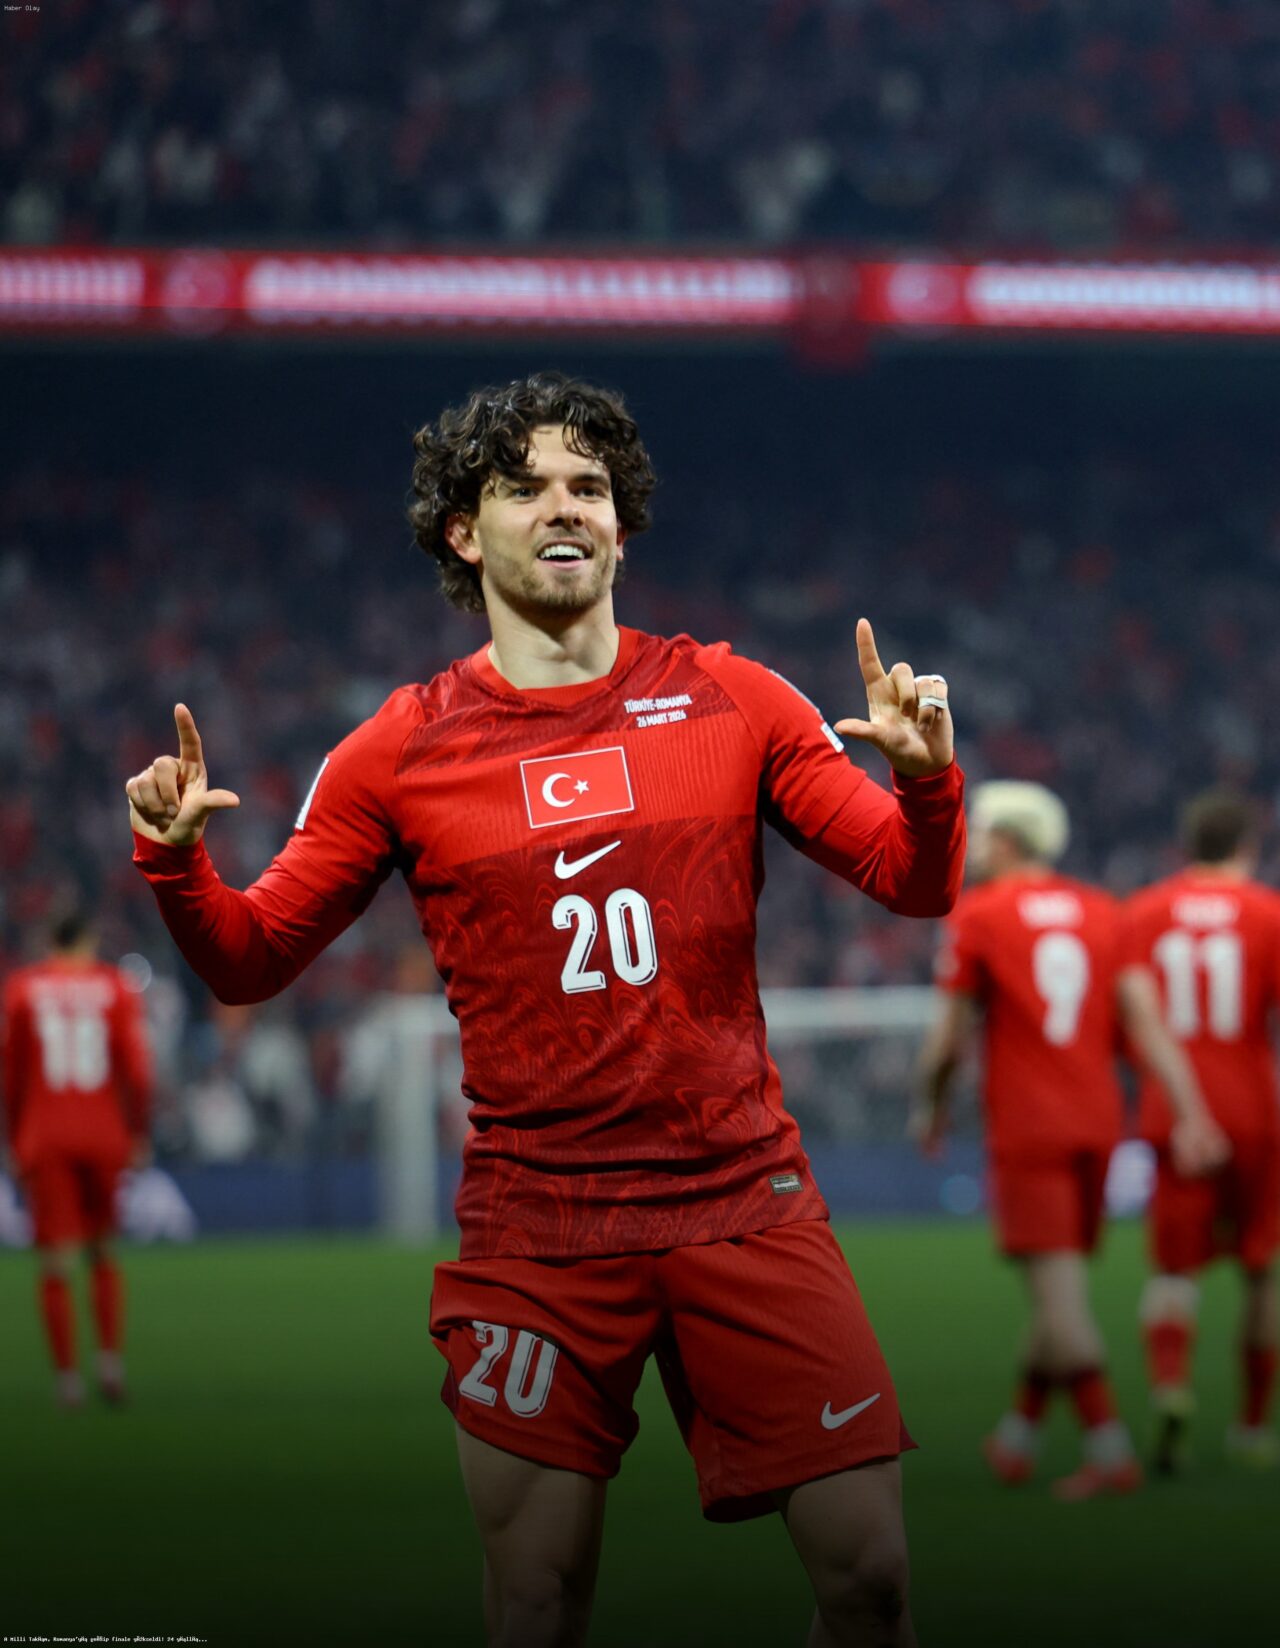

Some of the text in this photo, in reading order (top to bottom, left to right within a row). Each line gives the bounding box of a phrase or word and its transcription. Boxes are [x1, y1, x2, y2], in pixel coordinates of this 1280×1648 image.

[646, 712, 668, 726] MART
[668, 709, 687, 723] 2026
[552, 888, 658, 994] 20
[1033, 929, 1090, 1045] 9
[1153, 928, 1242, 1039] 11
[459, 1320, 559, 1418] 20
